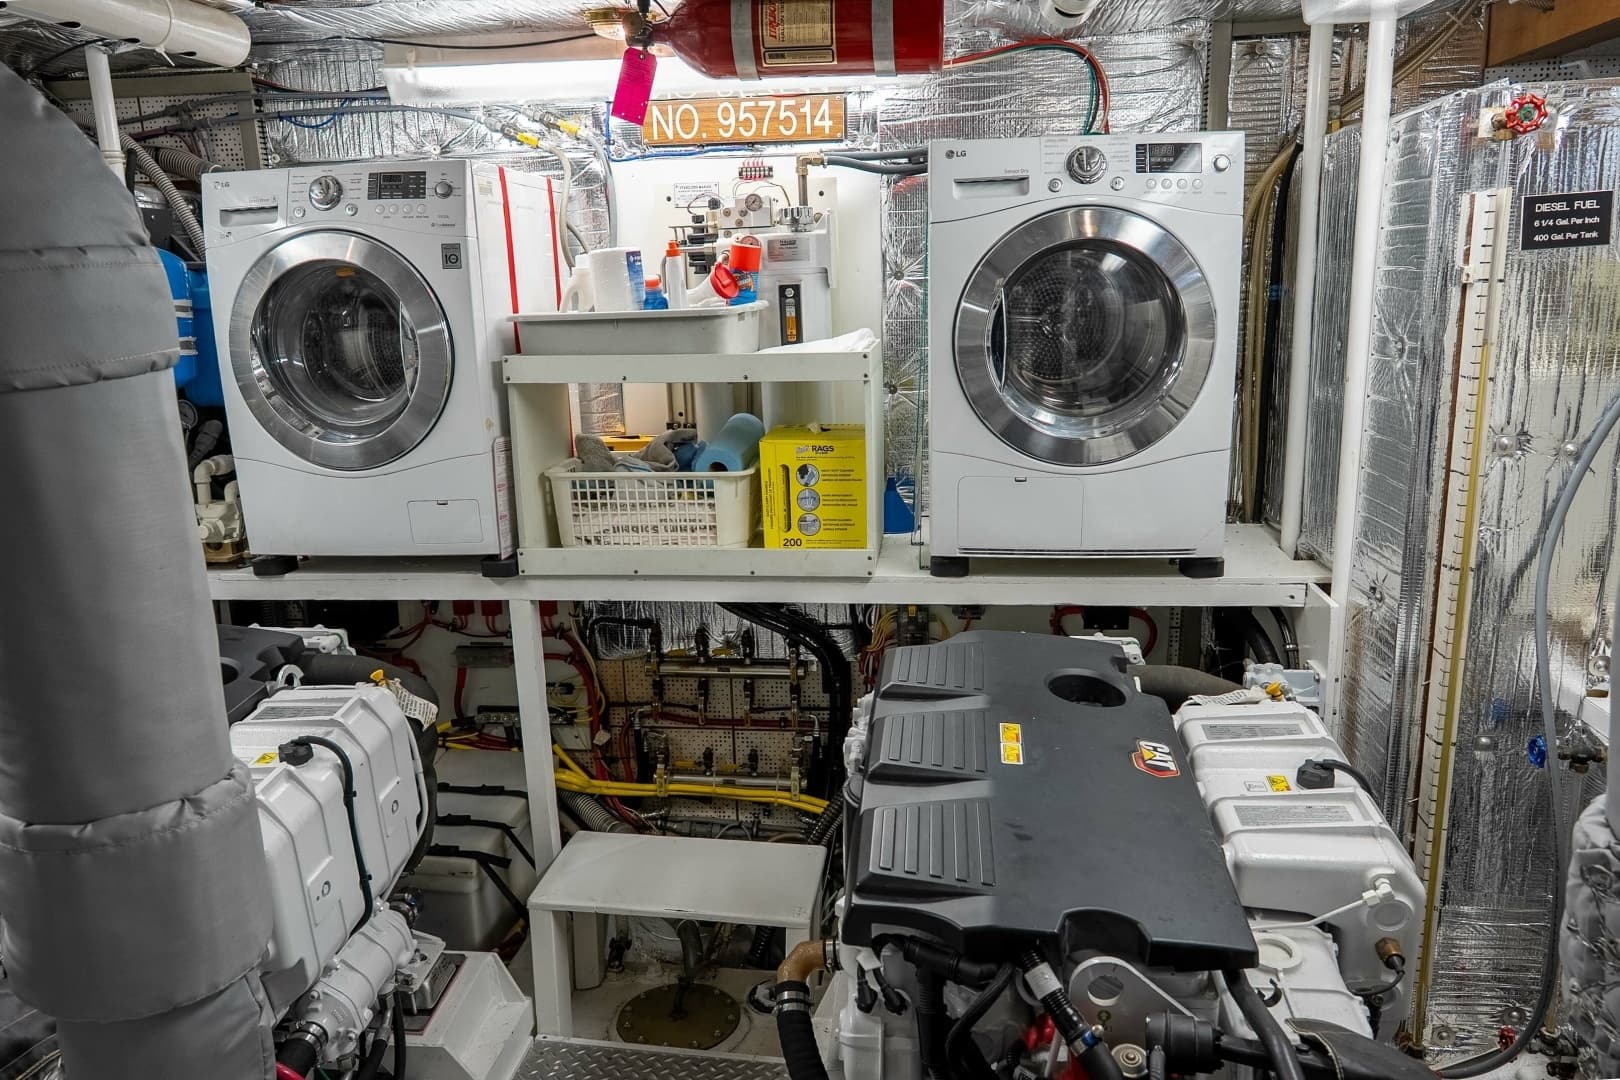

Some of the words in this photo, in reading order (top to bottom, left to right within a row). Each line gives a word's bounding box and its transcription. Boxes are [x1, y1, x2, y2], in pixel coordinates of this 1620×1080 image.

[651, 103, 708, 140] NO.
[716, 98, 833, 139] 957514
[1536, 202, 1570, 212] DIESEL
[1574, 200, 1600, 209] FUEL
[783, 538, 802, 547] 200
[1138, 740, 1177, 771] CAT
